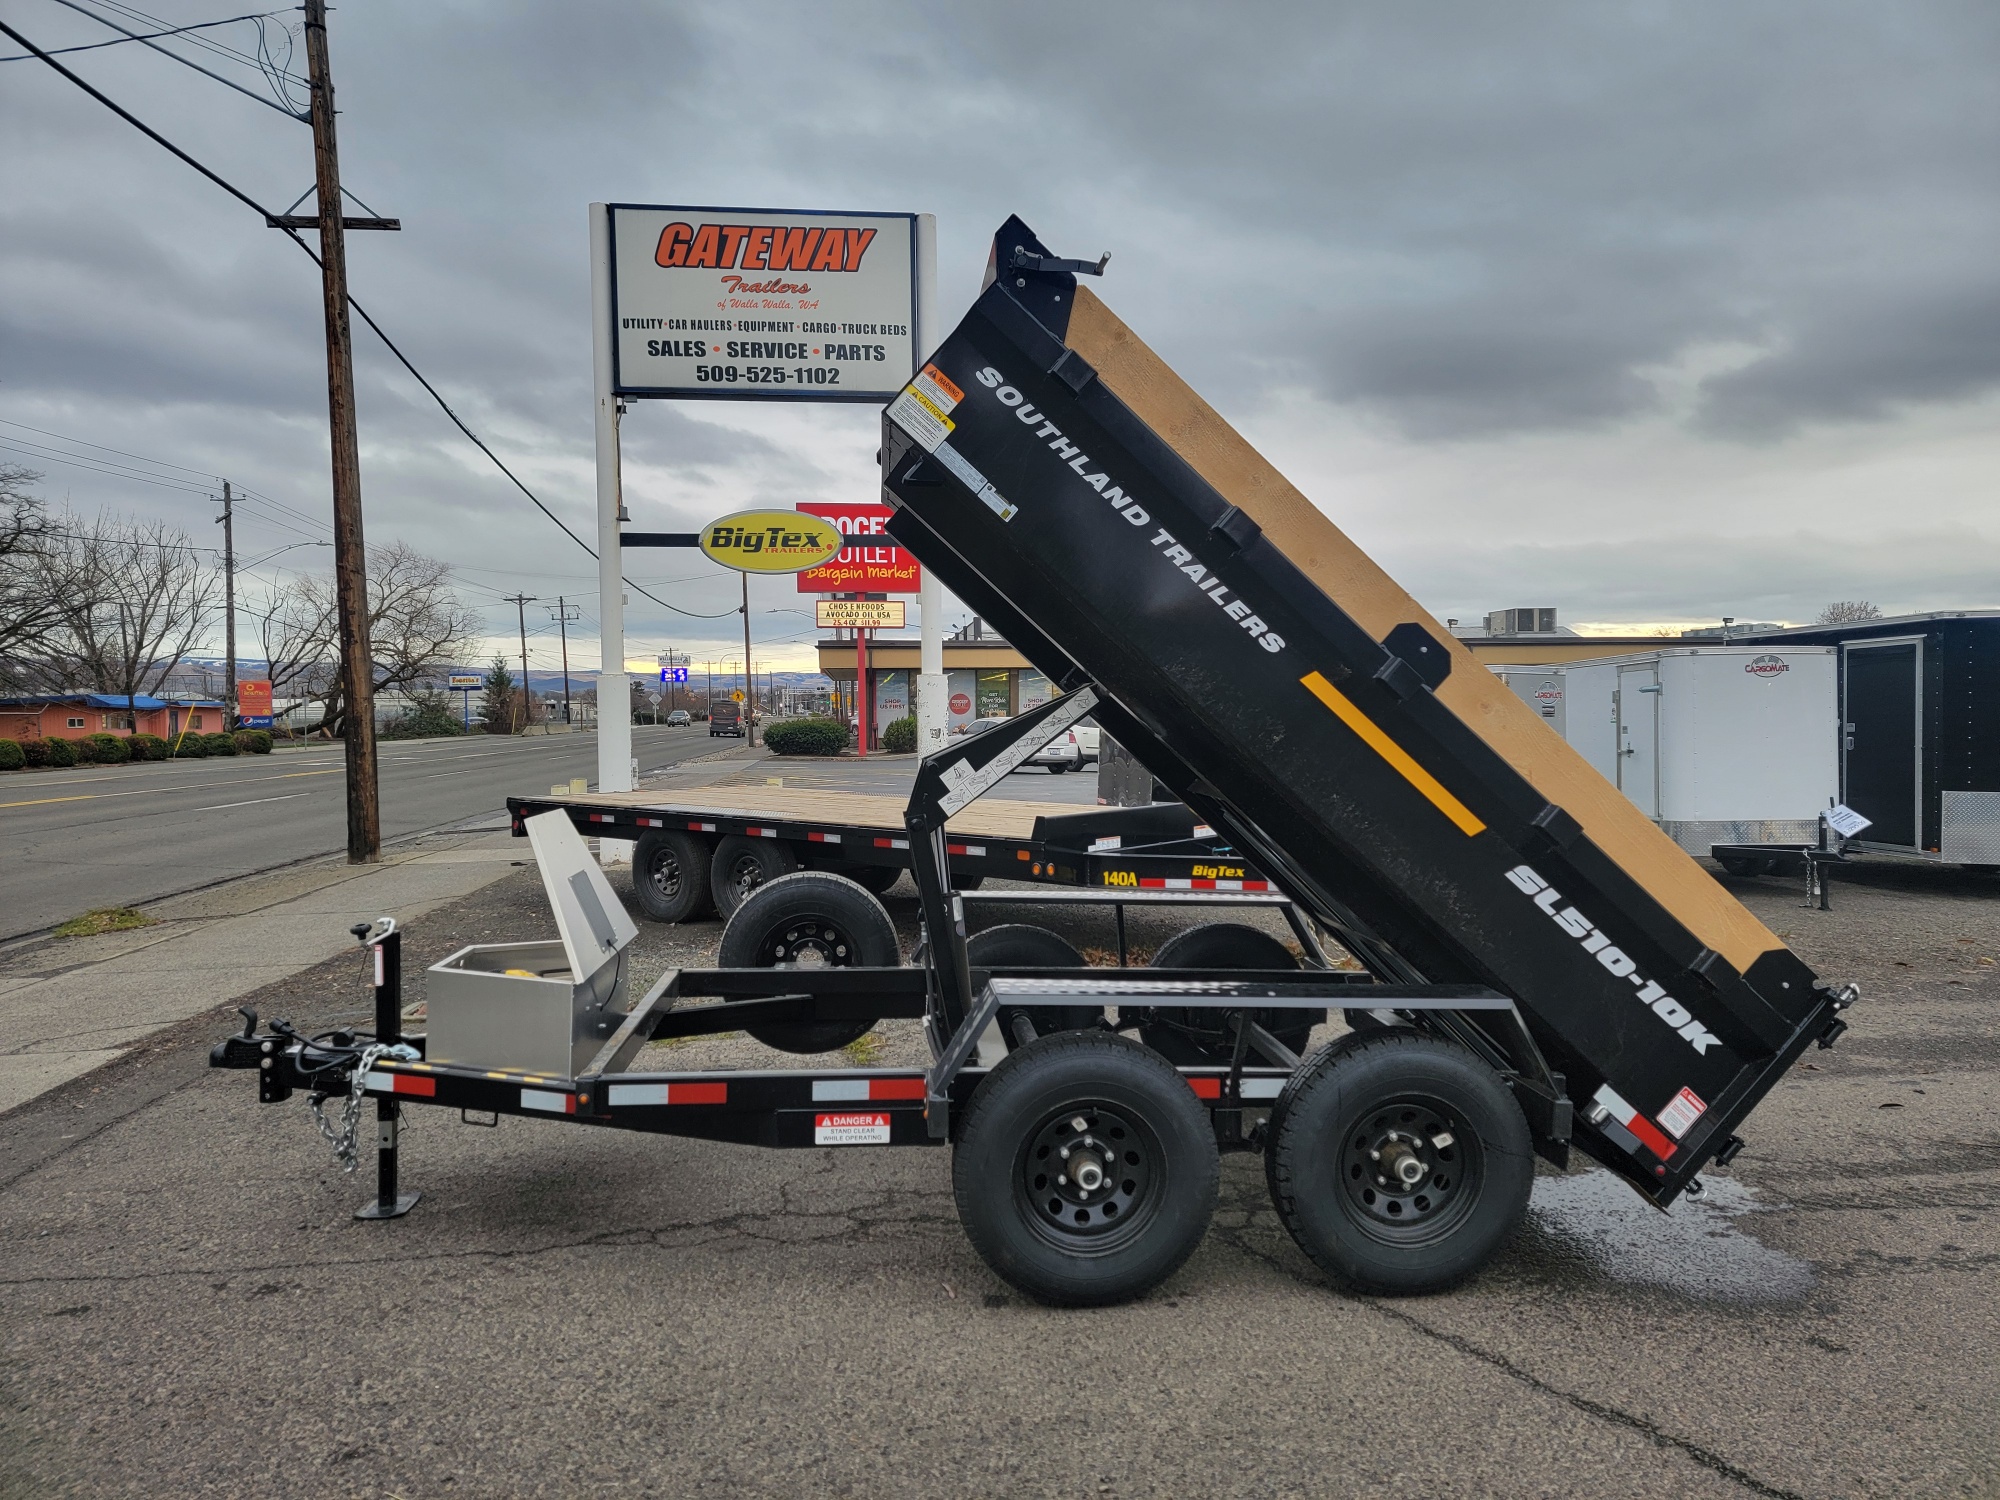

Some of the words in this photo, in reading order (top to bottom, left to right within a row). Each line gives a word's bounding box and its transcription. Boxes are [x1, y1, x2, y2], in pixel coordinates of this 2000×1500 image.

[654, 222, 878, 273] GATEWAY
[720, 275, 812, 295] Trailers
[717, 298, 727, 311] of
[729, 298, 759, 310] Walla
[798, 299, 820, 310] WA
[622, 318, 664, 330] UTILITY
[668, 319, 689, 331] CAR
[690, 320, 732, 332] HAULERS
[737, 320, 795, 333] EQUIPMENT
[802, 321, 837, 334] CARGO
[841, 322, 877, 335] TRUCK
[880, 324, 907, 336] BEDS
[647, 340, 707, 357] SALES
[726, 341, 809, 360] SERVICE
[824, 343, 886, 361] PARTS
[696, 365, 840, 385] 509-525-1102
[938, 376, 960, 398] WARNING
[918, 396, 943, 419] CAUTION
[975, 366, 1151, 526] SOUTHLAND
[1149, 527, 1287, 653] TRAILERS
[1103, 871, 1137, 887] 140A
[1503, 865, 1723, 1057] SL510-10K
[833, 1117, 873, 1125] DANGER
